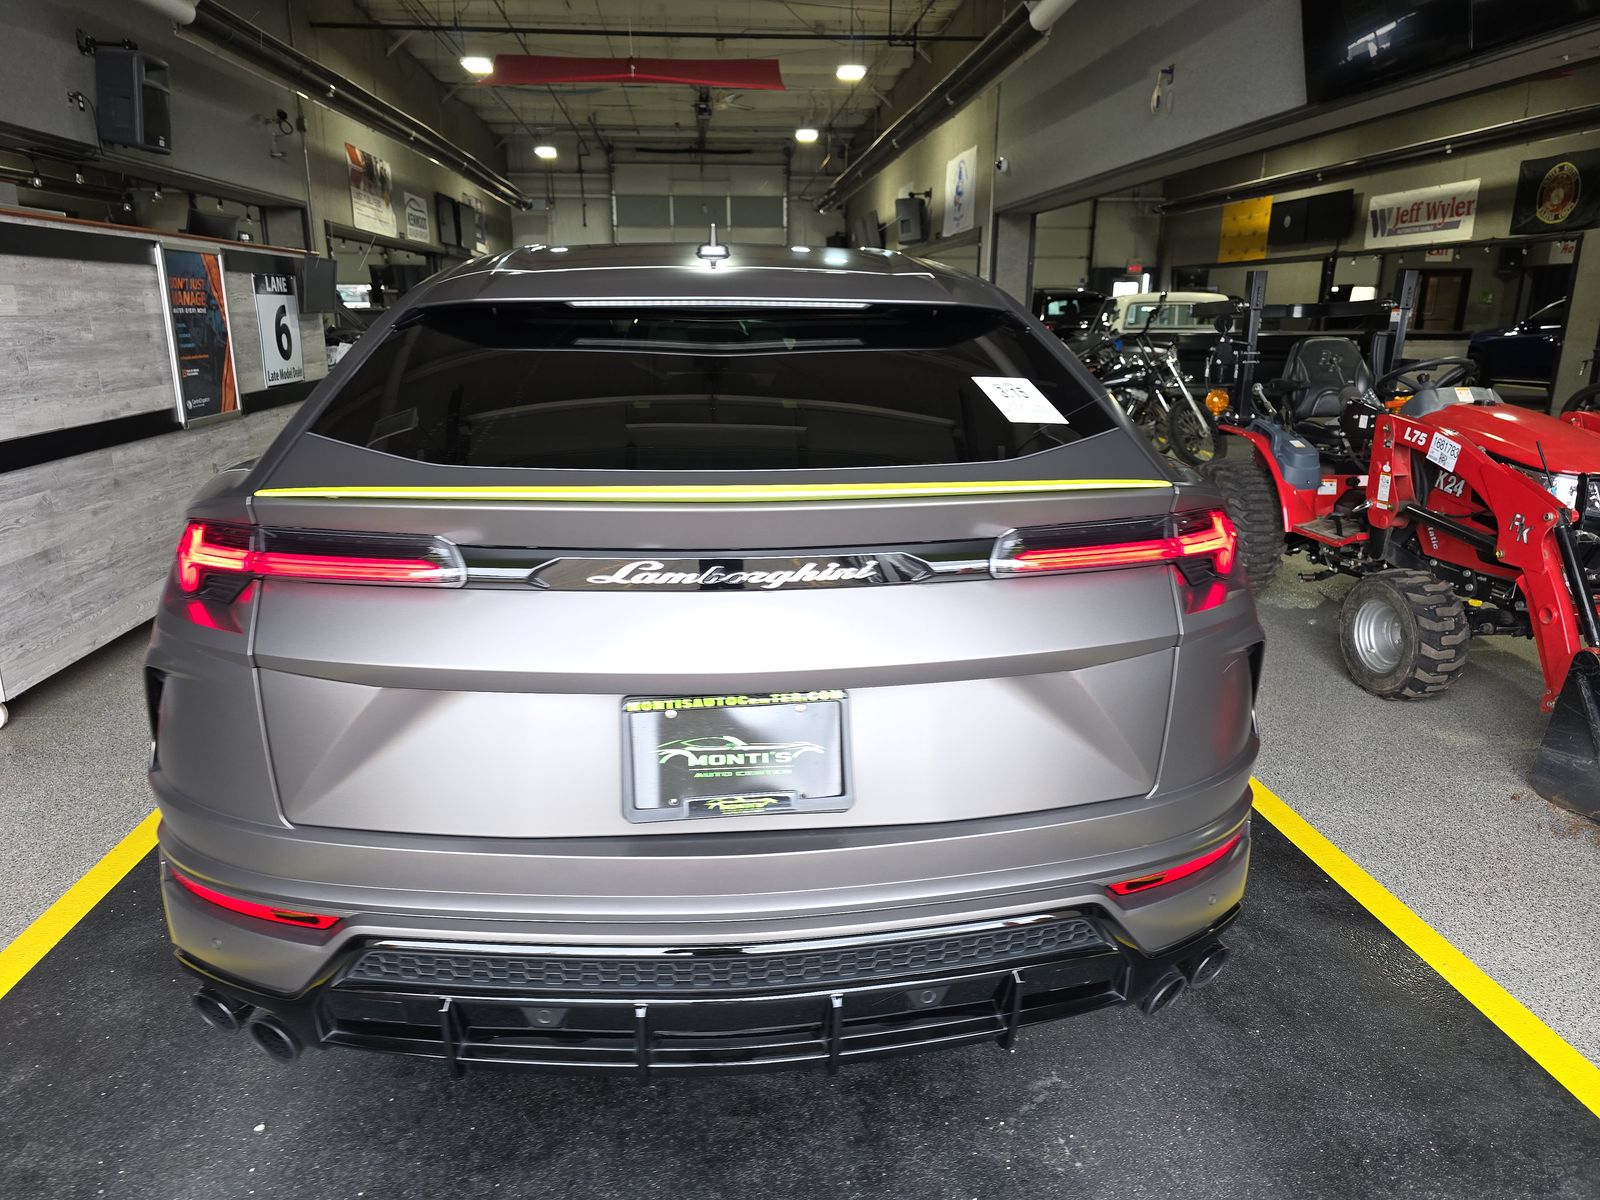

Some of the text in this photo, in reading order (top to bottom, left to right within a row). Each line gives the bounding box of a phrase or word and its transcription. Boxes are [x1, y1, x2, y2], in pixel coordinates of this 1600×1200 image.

[1393, 201, 1424, 231] Jeff
[1425, 196, 1475, 228] Wyler
[264, 275, 288, 293] LANE
[275, 304, 293, 361] 6
[267, 370, 280, 382] Late
[280, 367, 292, 380] Model
[1403, 426, 1428, 446] L75
[1433, 436, 1460, 459] 1681783
[585, 559, 880, 590] Lamborghini
[687, 751, 793, 767] MONTI'S
